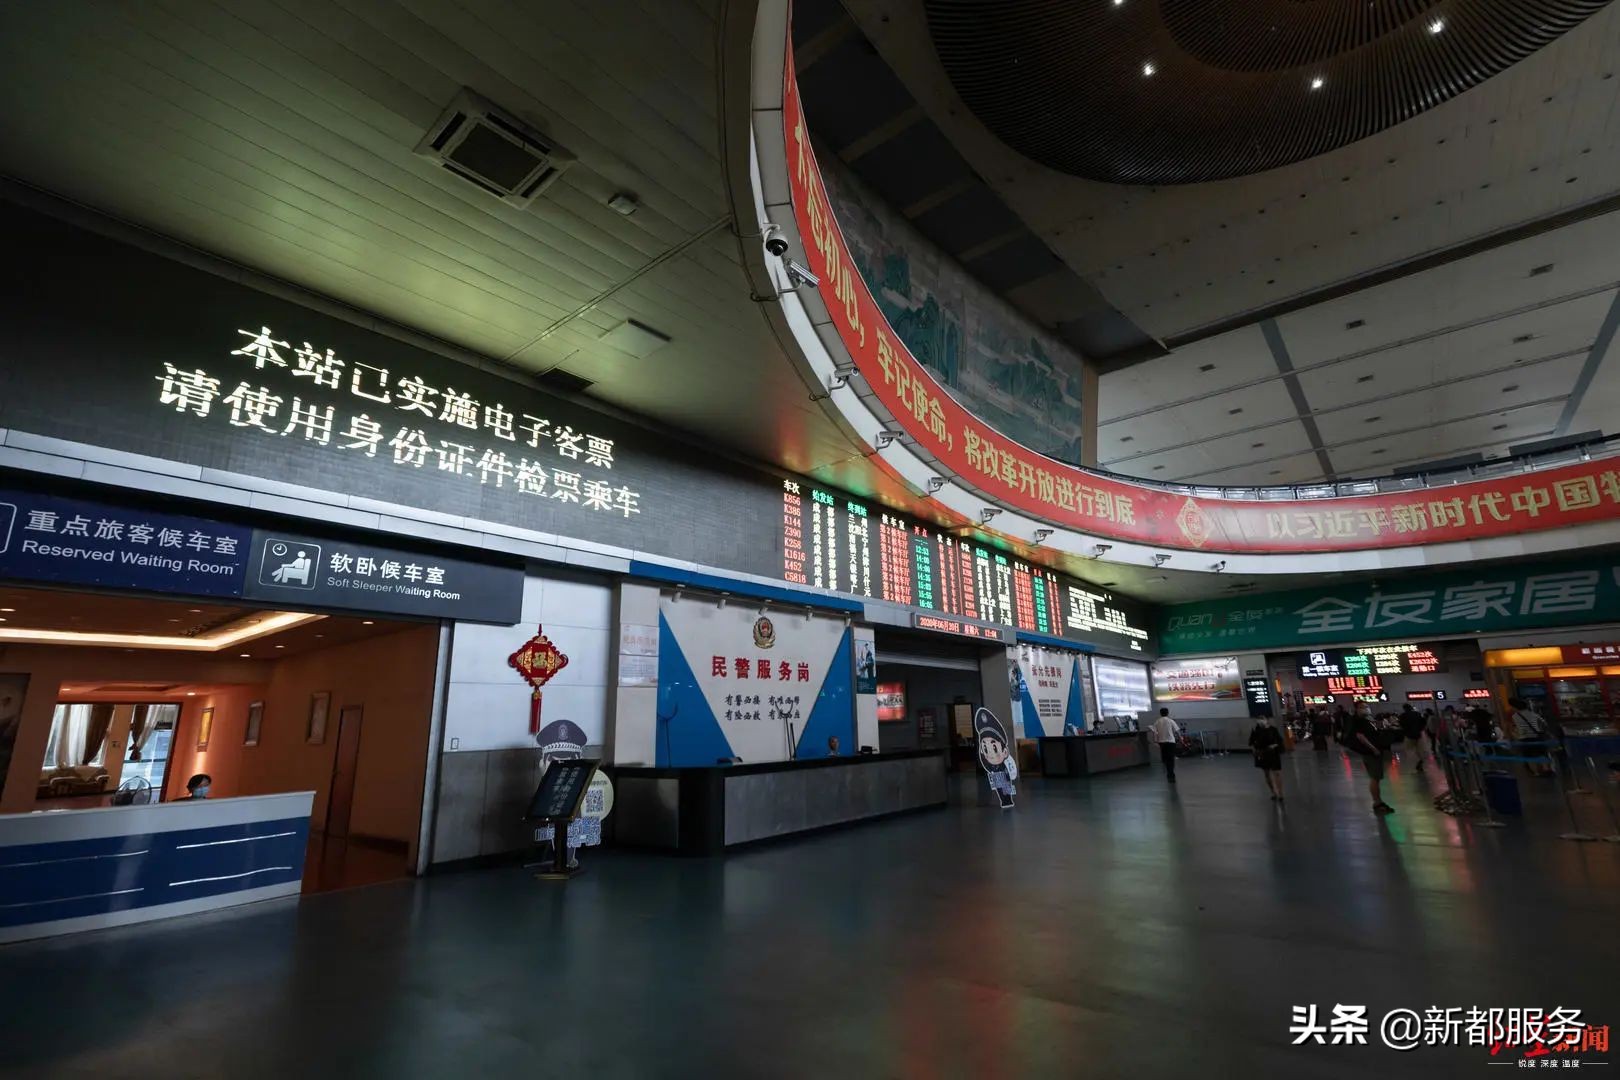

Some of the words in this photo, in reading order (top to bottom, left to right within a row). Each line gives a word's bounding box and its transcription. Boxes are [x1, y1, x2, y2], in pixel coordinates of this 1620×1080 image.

[231, 325, 615, 469] 本站已实施电子客票
[154, 361, 641, 518] 请使用身份证件检票乘车
[784, 493, 801, 506] K856
[24, 508, 239, 564] 重点旅客候车室
[784, 515, 801, 528] K144
[22, 540, 115, 565] Reserved
[119, 549, 183, 578] Waiting
[187, 561, 234, 577] Room
[329, 551, 446, 586] 软卧候车室
[784, 559, 802, 572] K452
[327, 576, 354, 592] Soft
[356, 581, 394, 599] Sleeper
[396, 586, 428, 602] Waiting
[431, 590, 461, 602] Room
[1294, 568, 1600, 636] 全友家居
[711, 655, 810, 682] 民警服务岗
[1437, 691, 1445, 699] 5
